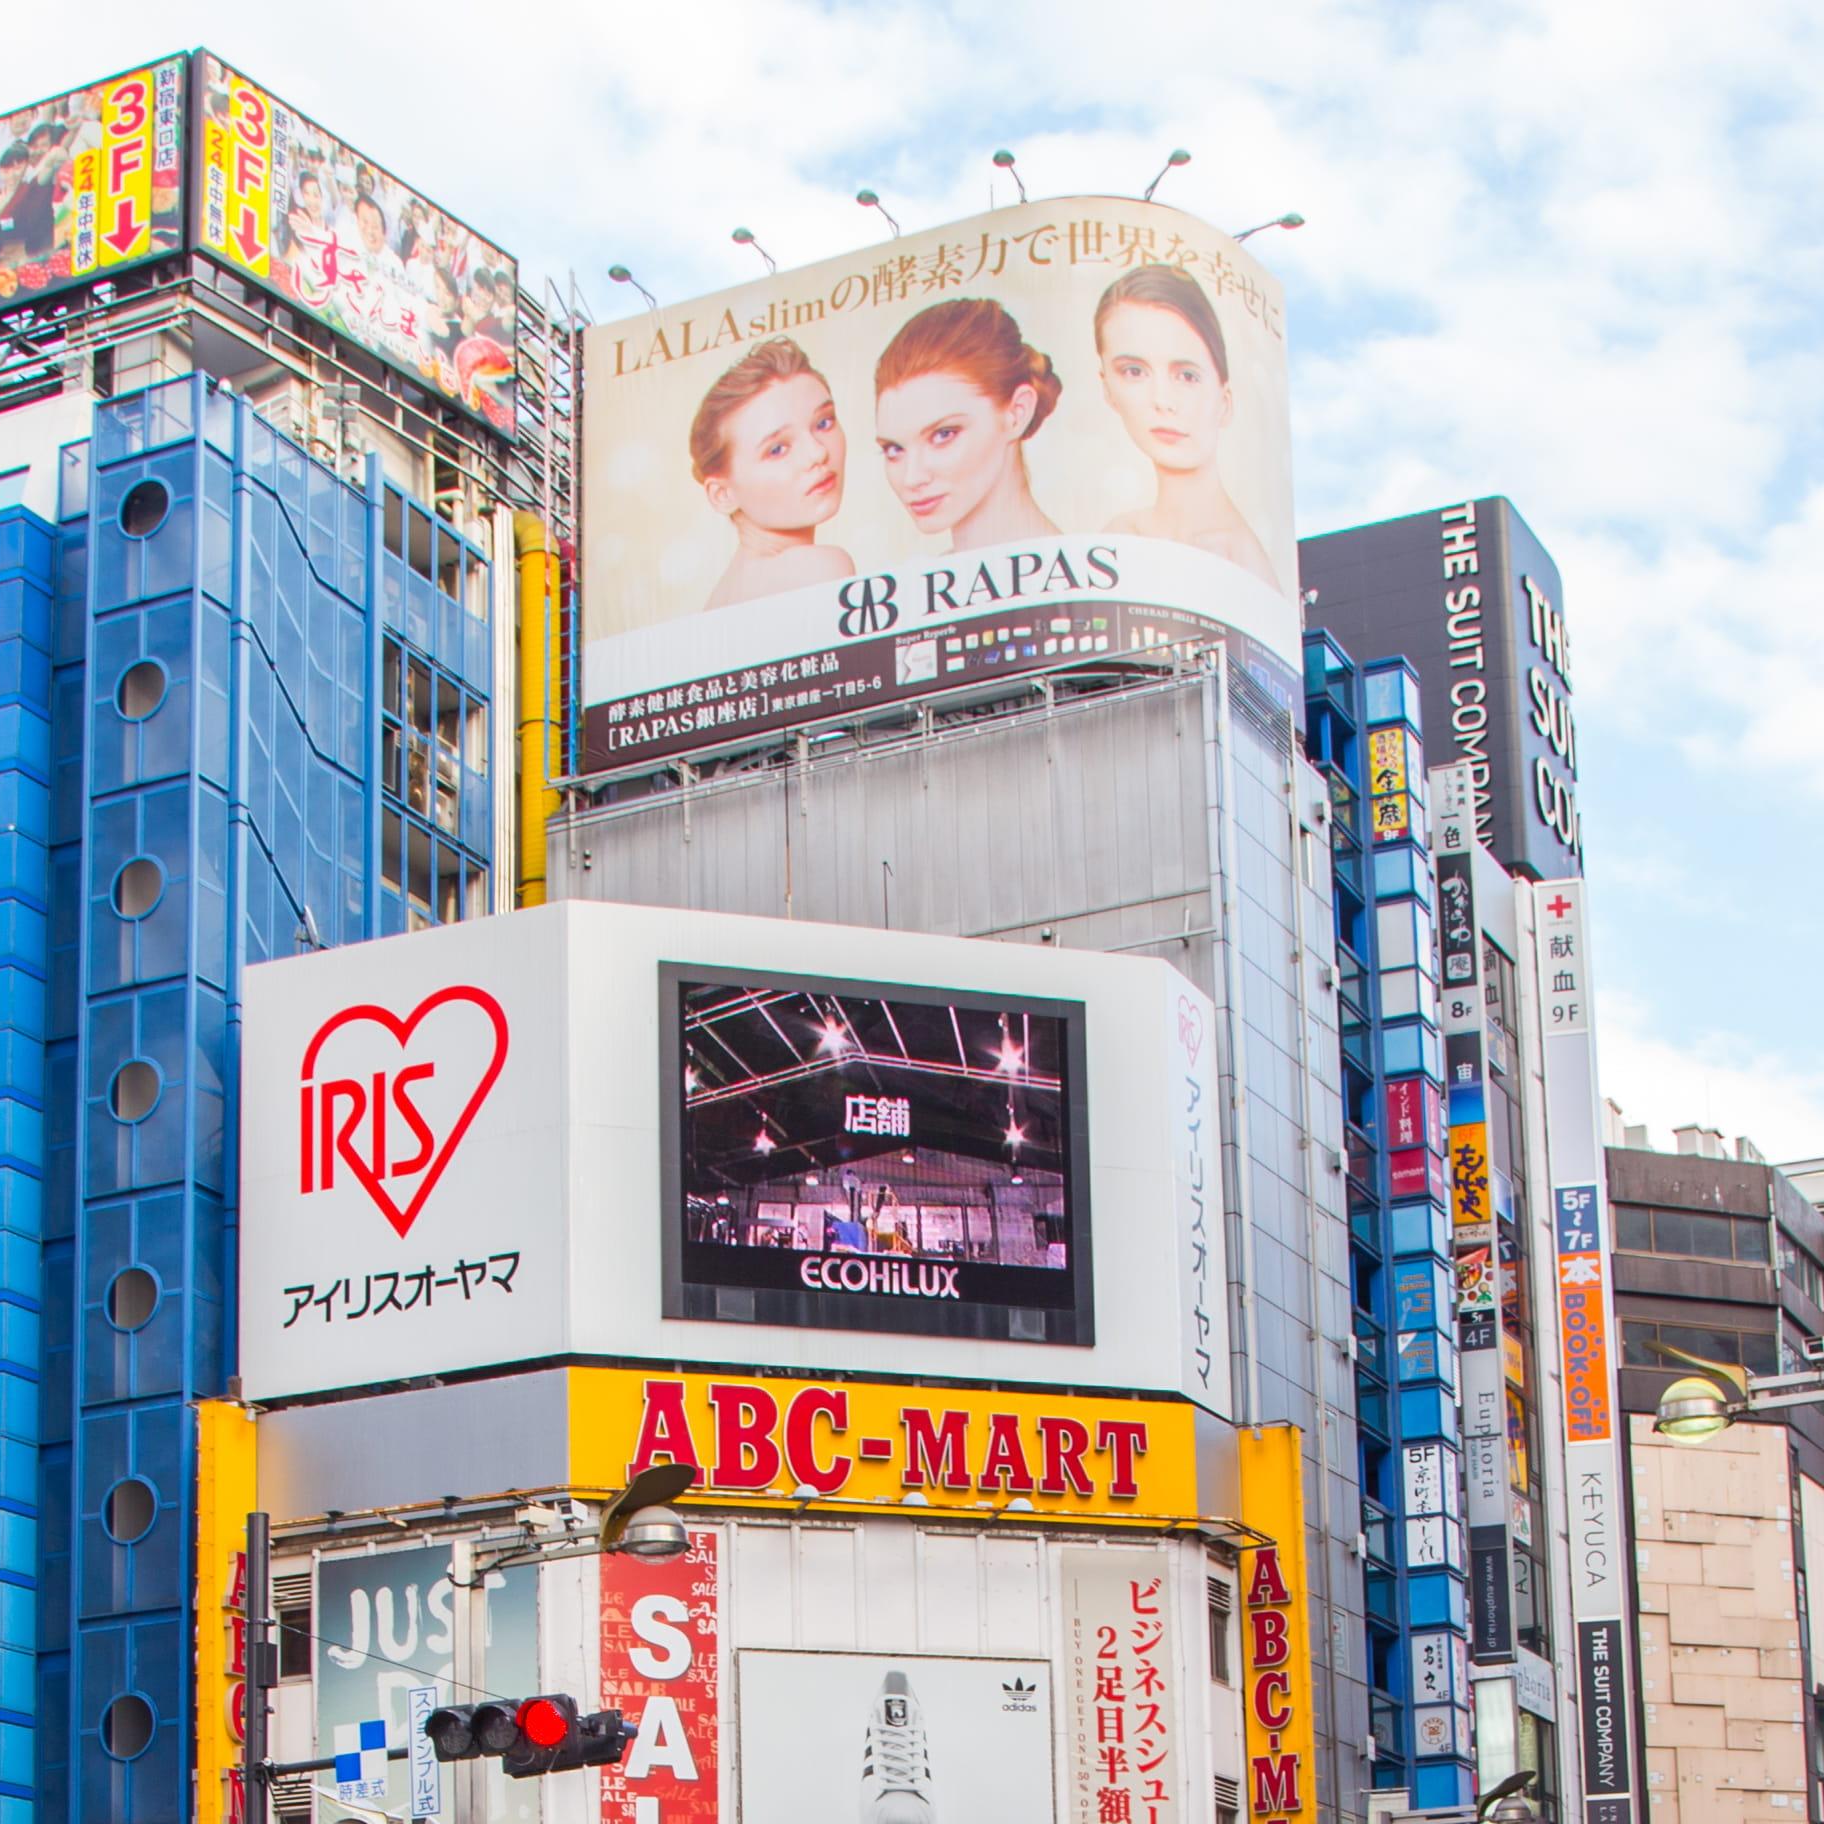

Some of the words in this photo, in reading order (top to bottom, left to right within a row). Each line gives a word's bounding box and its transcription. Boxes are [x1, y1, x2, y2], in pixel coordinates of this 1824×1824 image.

[110, 82, 147, 194] 3F
[157, 68, 177, 170] 新宿東口店
[235, 90, 267, 197] 3F
[1441, 499, 1479, 580] THE
[922, 546, 1120, 617] RAPAS
[1445, 585, 1485, 671] SUIT
[1549, 935, 1577, 993] 献血
[1450, 1002, 1473, 1018] 8F
[1552, 1004, 1580, 1025] 9F
[300, 1060, 436, 1197] IRIS
[842, 1095, 911, 1140] 店舗
[1562, 1191, 1591, 1210] 5F
[1182, 1074, 1214, 1393] アイリスオーヤマ
[1564, 1230, 1593, 1250] 7F
[283, 1250, 524, 1330] アイリスオーヤマ
[1561, 1256, 1602, 1285] 本
[1465, 1328, 1491, 1347] 4F
[628, 1379, 1150, 1498] ABC-MART
[1408, 1447, 1436, 1464] 5F
[1475, 1391, 1497, 1500] Euphoria
[1580, 1472, 1607, 1589] KEYUCA
[1591, 1627, 1609, 1661] THE
[1001, 1703, 1038, 1713] adidas
[1594, 1665, 1611, 1703] SUIT
[1595, 1705, 1616, 1788] COMPANY
[338, 1778, 386, 1802] 時差式
